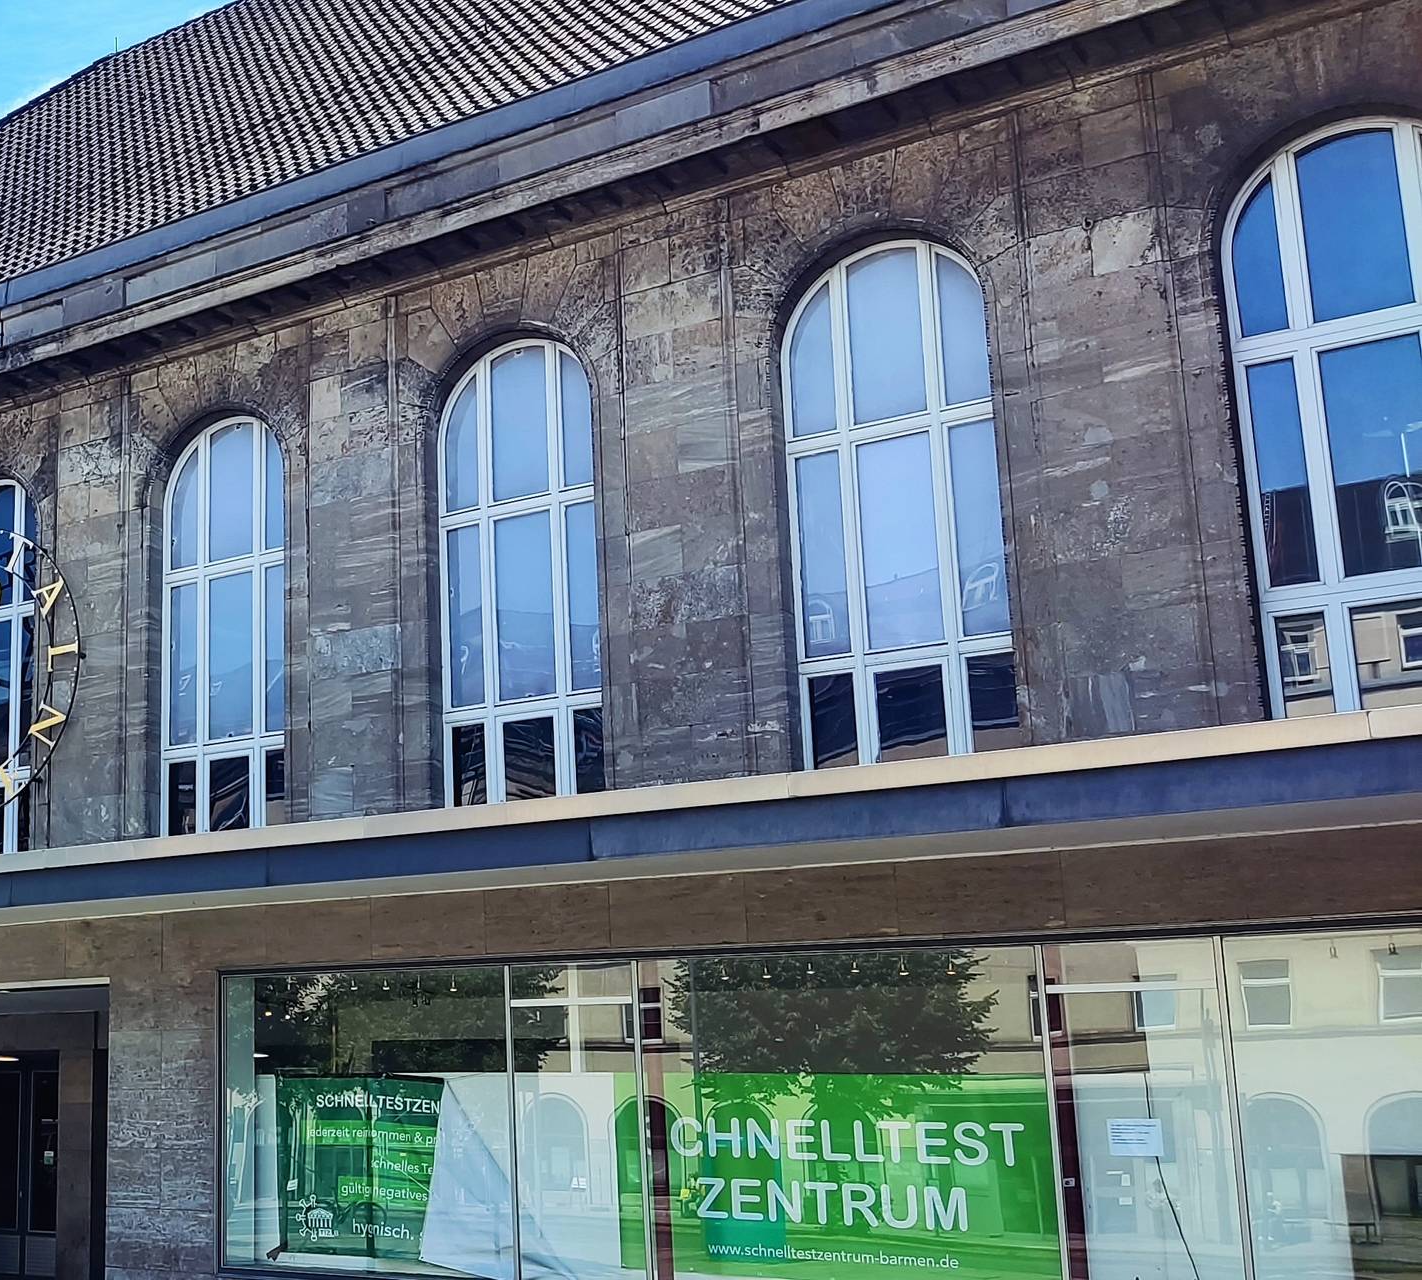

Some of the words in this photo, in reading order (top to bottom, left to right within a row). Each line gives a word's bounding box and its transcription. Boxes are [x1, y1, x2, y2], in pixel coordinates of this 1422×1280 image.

[645, 1115, 1025, 1168] CHNELLTEST
[696, 1176, 969, 1233] ZENTRUM
[708, 1242, 960, 1270] www.schnelltestzentrum-barmen.de
